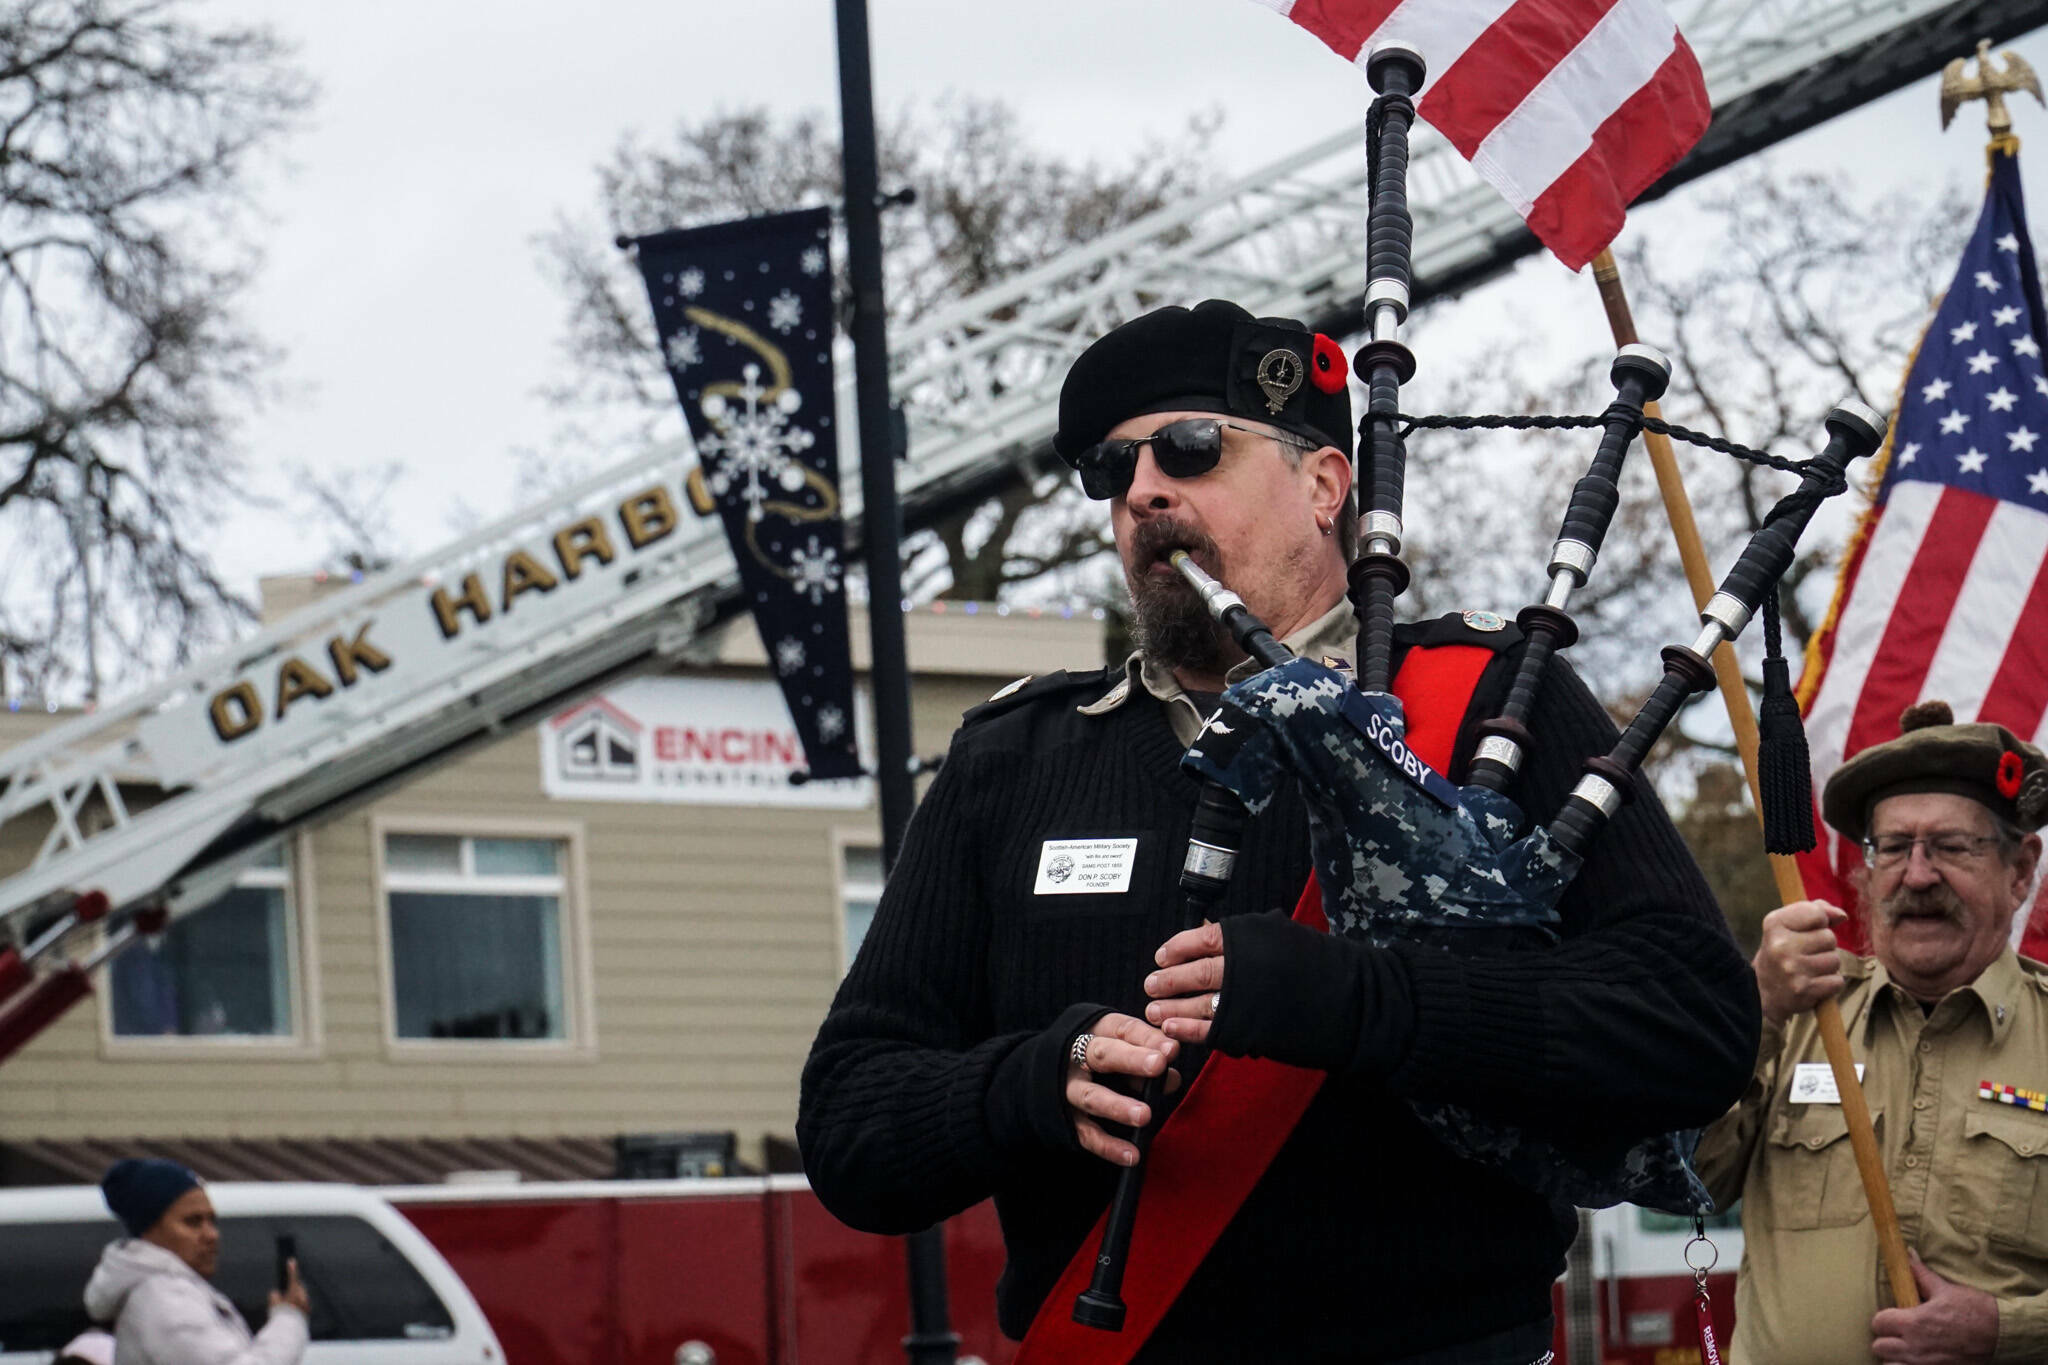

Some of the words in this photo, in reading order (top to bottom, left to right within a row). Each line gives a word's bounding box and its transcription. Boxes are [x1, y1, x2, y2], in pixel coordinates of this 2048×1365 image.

[209, 619, 392, 743] OAK
[653, 727, 808, 768] ENCIN
[1366, 713, 1432, 785] SCOBY
[1093, 842, 1111, 850] Military
[1112, 841, 1131, 849] Society
[1078, 873, 1092, 881] DON
[1099, 873, 1122, 881] SCOBY
[1703, 1325, 1720, 1365] REMOV
